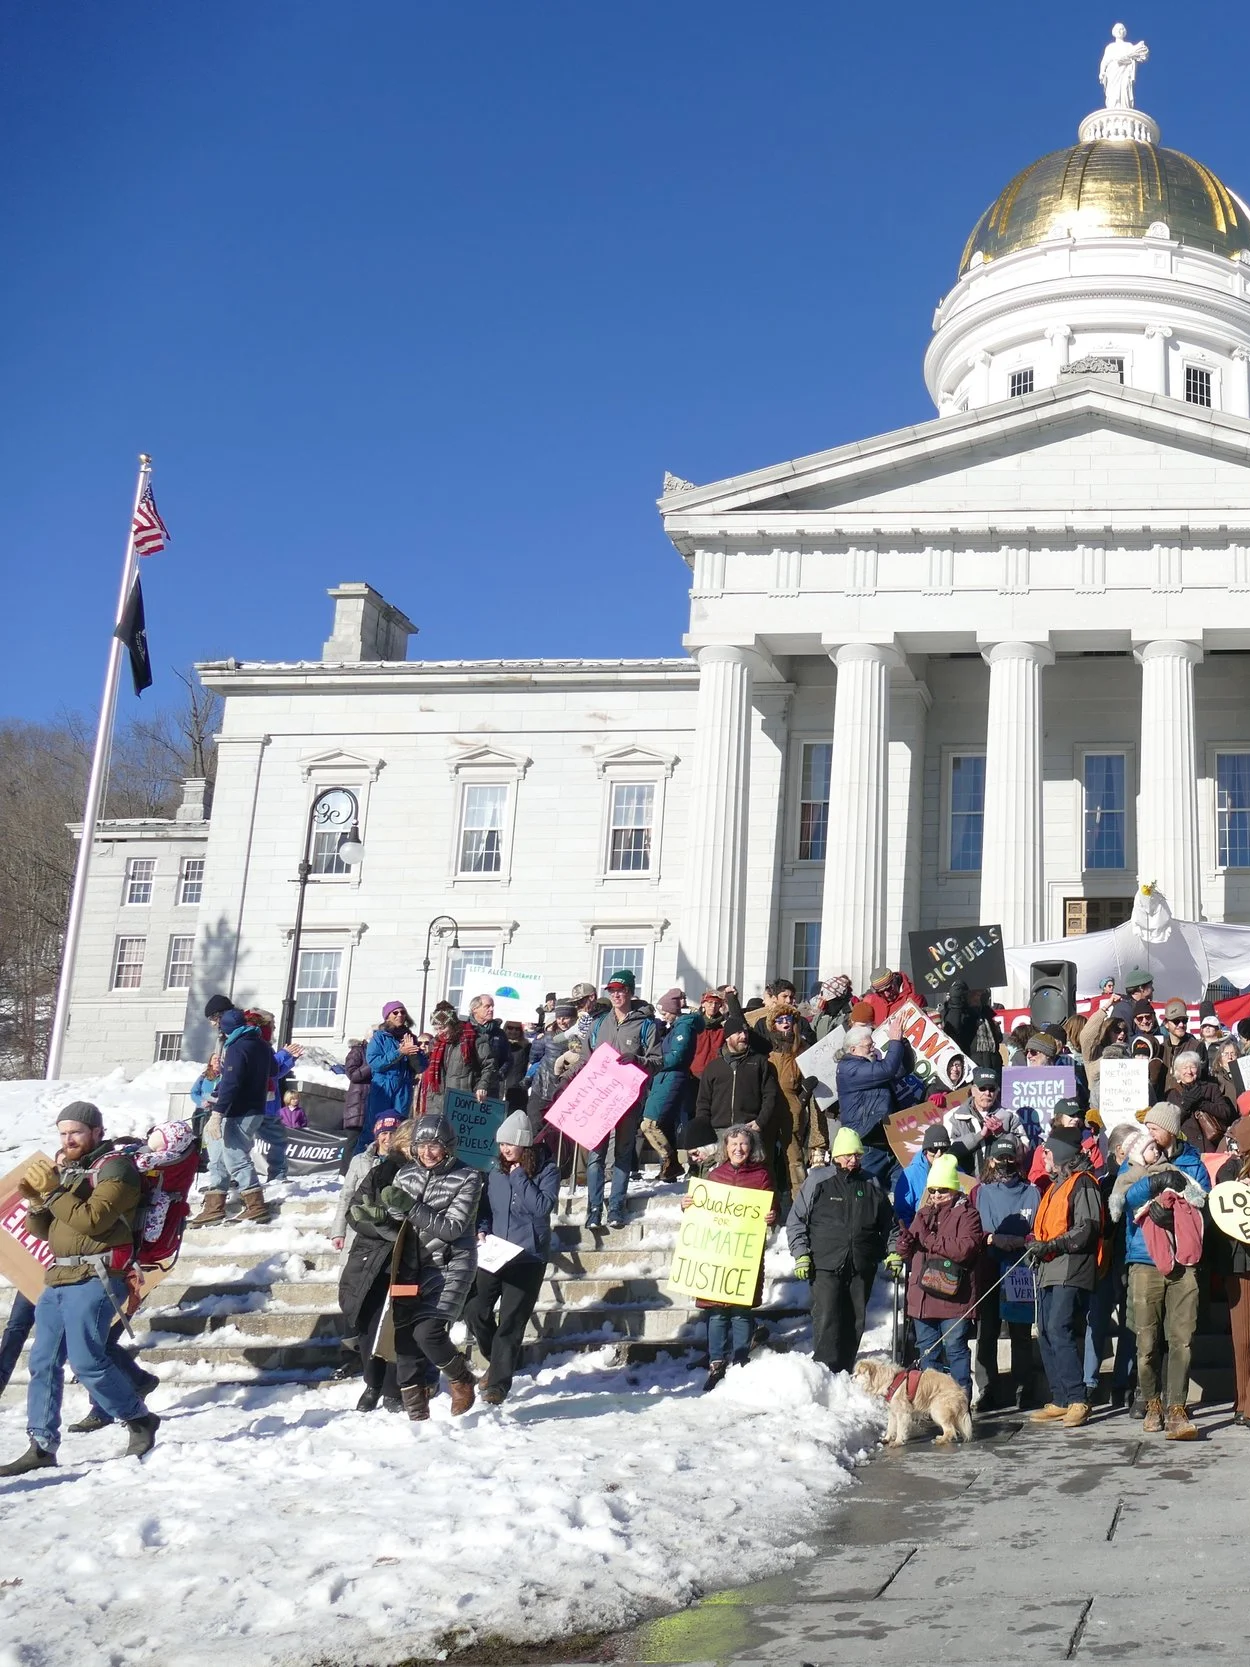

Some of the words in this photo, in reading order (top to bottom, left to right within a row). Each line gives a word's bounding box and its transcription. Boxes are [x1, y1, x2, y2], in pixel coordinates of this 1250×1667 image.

[924, 927, 1000, 989] BIOFUELS
[928, 937, 958, 962] NO
[1012, 1079, 1065, 1096] SYSTEM
[479, 1102, 493, 1115] BE
[574, 1077, 625, 1128] Standing
[451, 1110, 488, 1126] FOOLED
[459, 1123, 474, 1136] BY
[299, 1144, 338, 1160] MORE
[692, 1184, 761, 1219] Quakers
[713, 1217, 730, 1226] FOR
[682, 1222, 758, 1259] CLIMATE
[672, 1256, 752, 1297] JUSTICE
